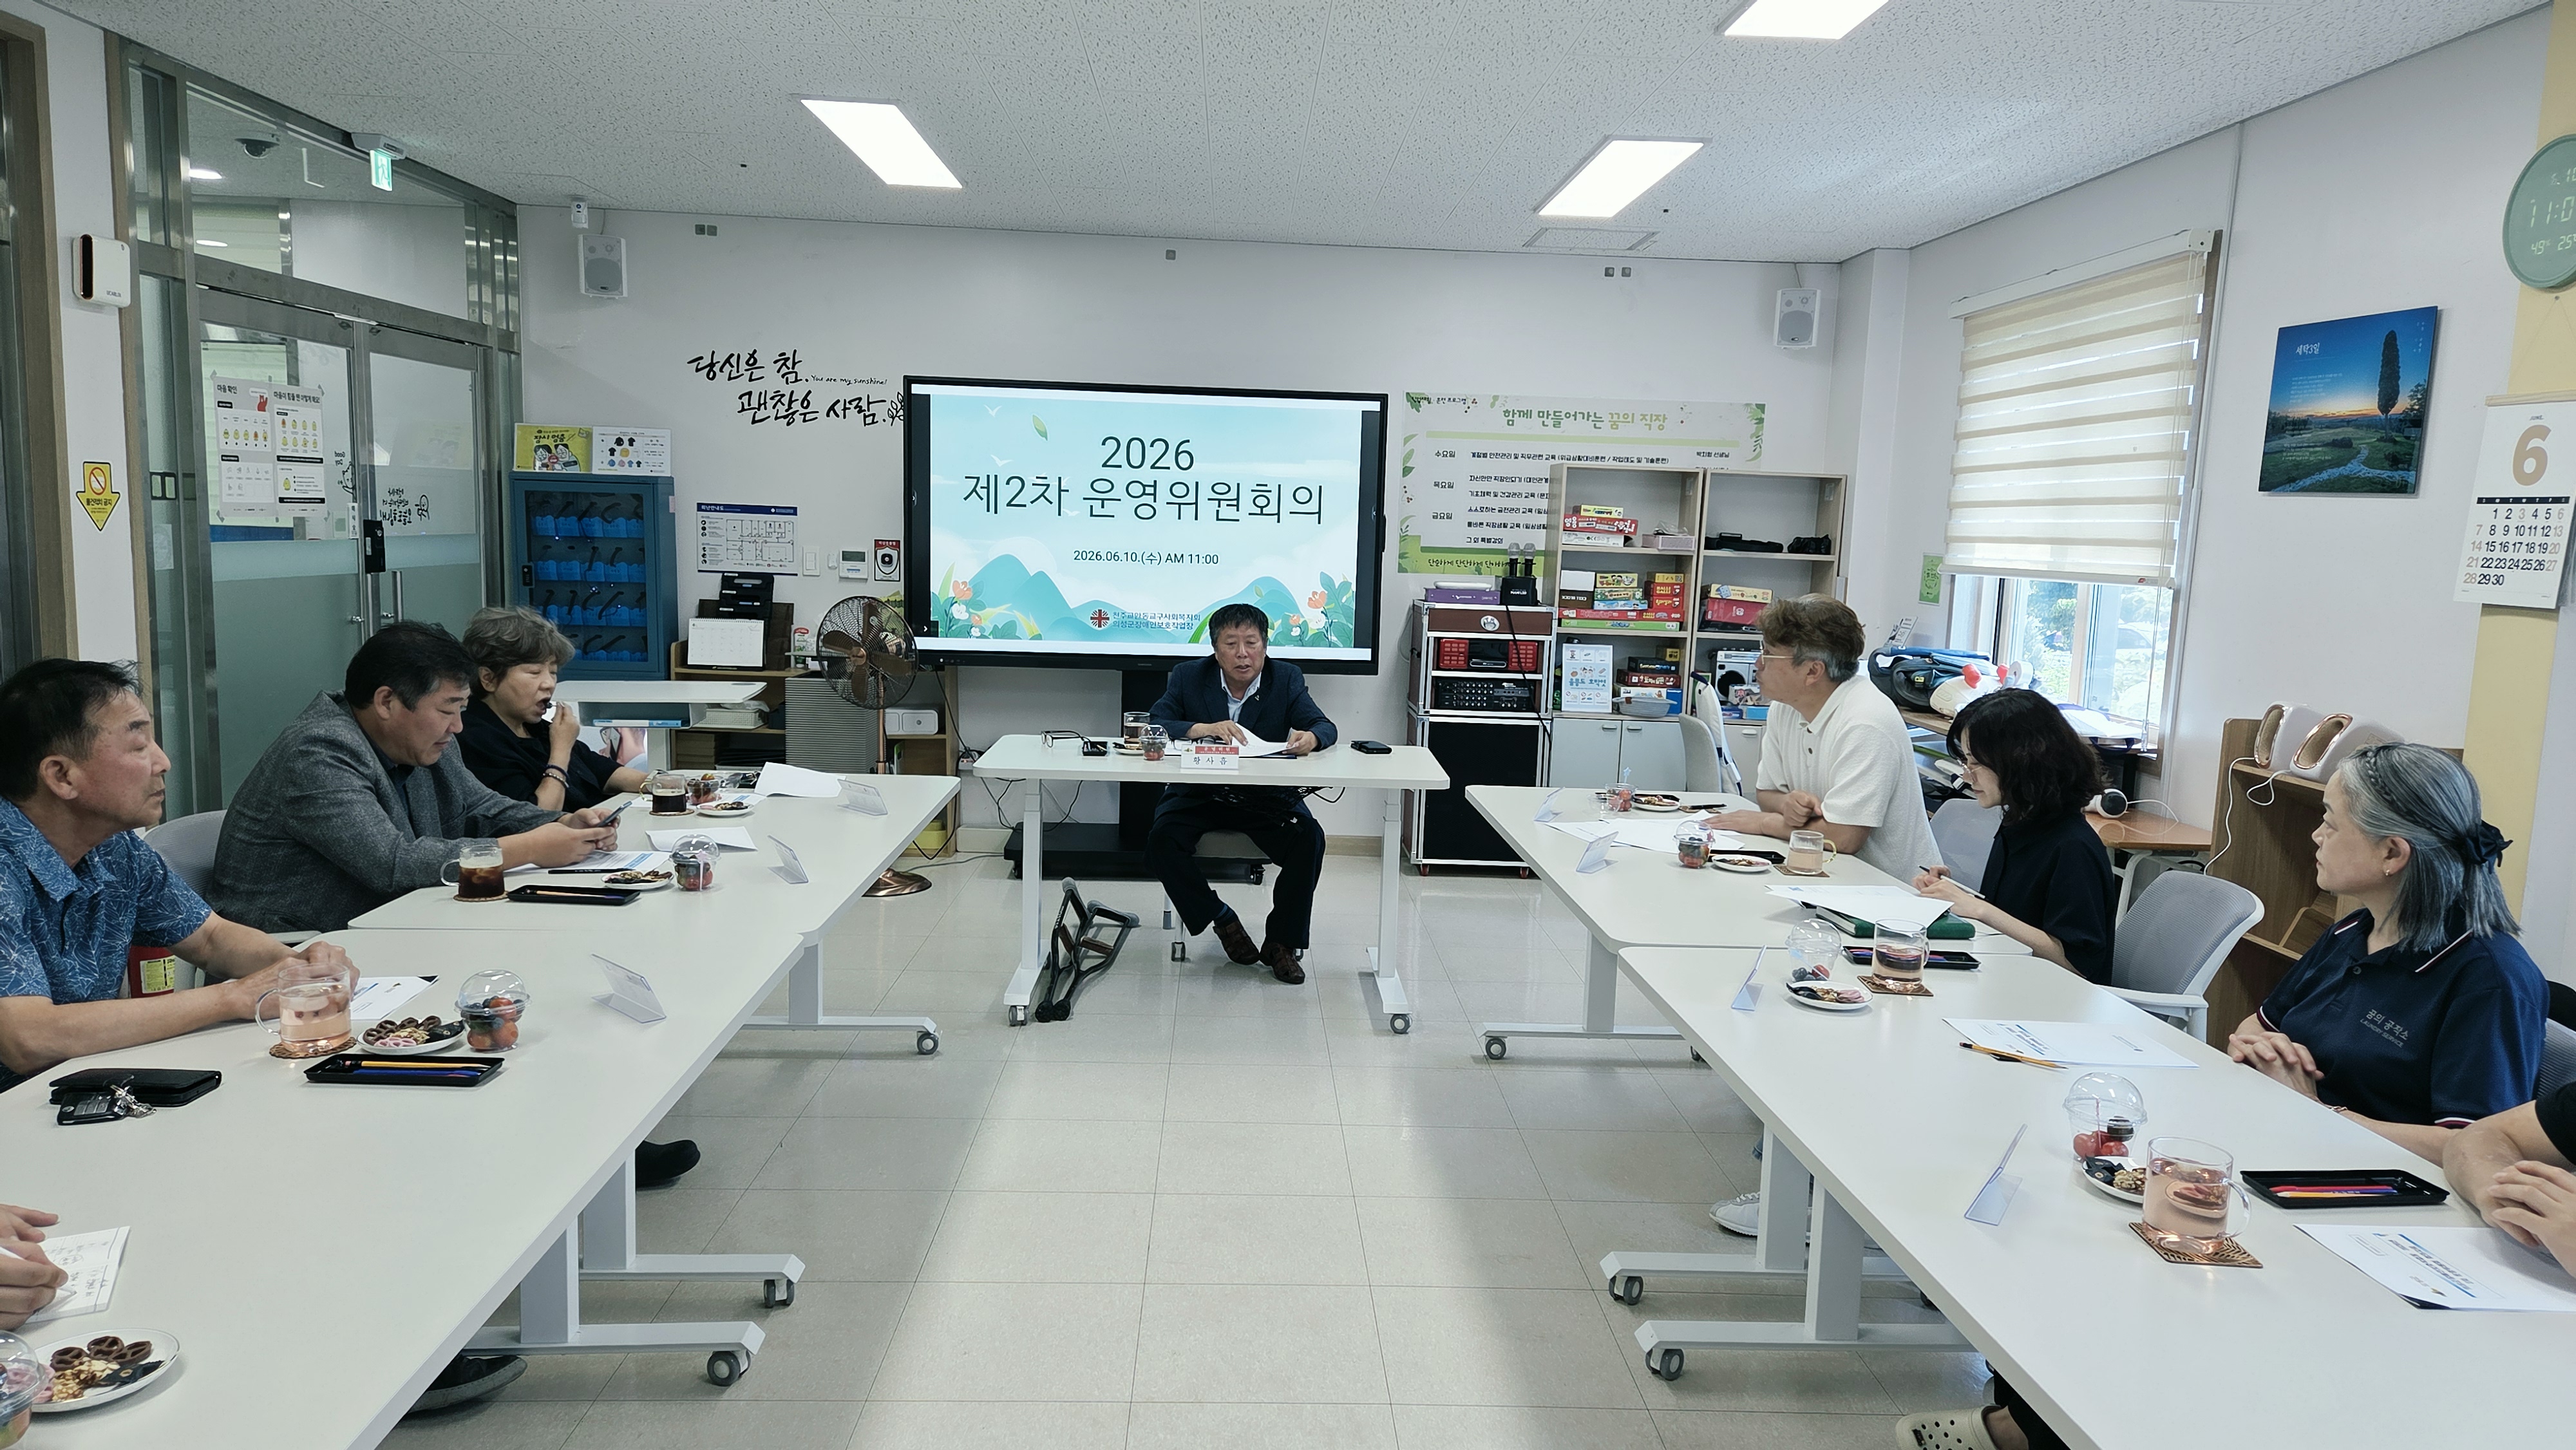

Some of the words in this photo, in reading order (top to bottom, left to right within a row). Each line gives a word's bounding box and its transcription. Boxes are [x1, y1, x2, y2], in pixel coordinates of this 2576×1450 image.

[687, 349, 765, 382] 당신은
[737, 390, 820, 427] 괜찮은
[1502, 408, 1532, 427] 함께
[1537, 410, 1604, 429] 만들어가는
[1608, 412, 1635, 430] 꿈의
[1640, 413, 1667, 431] 직장
[1101, 436, 1195, 471] 2026
[2512, 424, 2551, 486] 6
[963, 474, 1070, 516] 제2차
[1083, 477, 1324, 524] 운영위원회의
[1432, 512, 1453, 520] 금요일
[2493, 508, 2498, 519] 1
[2505, 508, 2512, 520] 2
[2518, 508, 2525, 520] 3
[2532, 508, 2538, 519] 4
[2544, 508, 2552, 520] 5
[2557, 508, 2564, 520] 6
[2476, 524, 2483, 535] 7
[2489, 525, 2496, 536] 8
[2503, 525, 2509, 536] 9
[2514, 525, 2525, 536] 10
[2528, 525, 2537, 536] 11
[2541, 525, 2551, 537] 12
[2553, 525, 2563, 537] 13
[2471, 541, 2482, 551] 14
[2485, 541, 2496, 552] 15
[2499, 541, 2509, 552] 16
[2512, 542, 2523, 553] 17
[2525, 542, 2535, 553] 18
[2538, 542, 2548, 554] 19
[2548, 543, 2560, 554] 20
[1073, 551, 1162, 565] 2026.06.10.(수)
[1165, 552, 1184, 564] AM
[1188, 553, 1219, 565] 11:00
[2467, 556, 2479, 567] 21
[2481, 558, 2494, 569] 22
[2494, 558, 2506, 569] 23
[2508, 558, 2520, 570] 24
[2521, 559, 2533, 570] 25
[2533, 560, 2545, 570] 26
[2546, 560, 2557, 571] 27
[2463, 573, 2477, 583] 28
[2478, 574, 2490, 585] 29
[2492, 575, 2504, 585] 30
[1113, 612, 1201, 621] 천주교안동교구사회복지회
[1113, 621, 1194, 630] 의성군장애인보호작업장
[2366, 1009, 2385, 1024] 꿈의
[2383, 1020, 2409, 1040] 공작소
[2382, 1031, 2404, 1048] SERVICE
